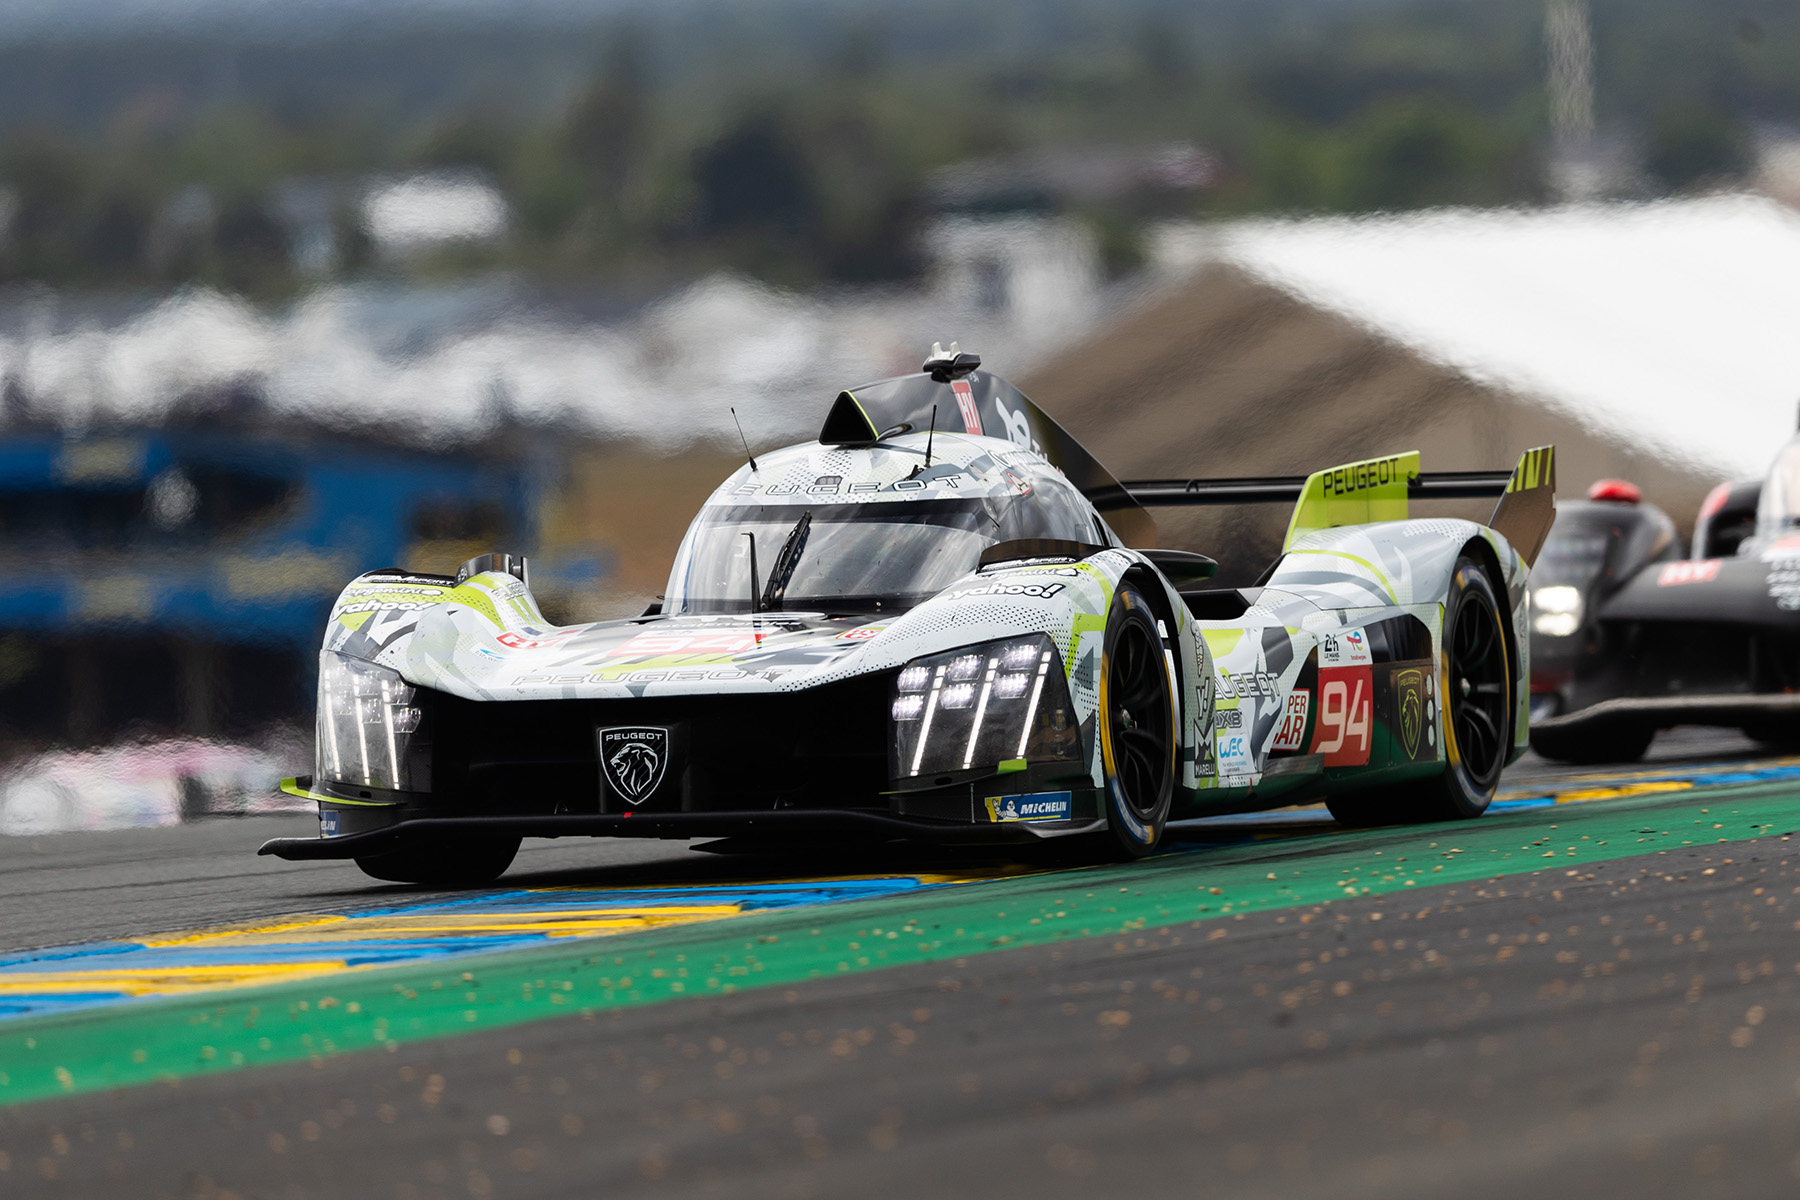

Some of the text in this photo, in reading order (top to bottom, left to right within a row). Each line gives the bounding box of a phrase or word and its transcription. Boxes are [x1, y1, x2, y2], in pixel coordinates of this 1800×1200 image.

[720, 474, 963, 497] PEUGEOT
[1322, 458, 1399, 498] PEUGEOT
[949, 583, 1067, 600] yahoo!
[333, 599, 441, 622] yahoo!
[510, 669, 792, 686] PEUGEOT
[1315, 679, 1369, 754] 94
[606, 733, 663, 742] PEUGEOT
[1218, 737, 1244, 759] WEC
[1195, 764, 1215, 776] MARELLI
[1020, 801, 1067, 815] MICHELIN
